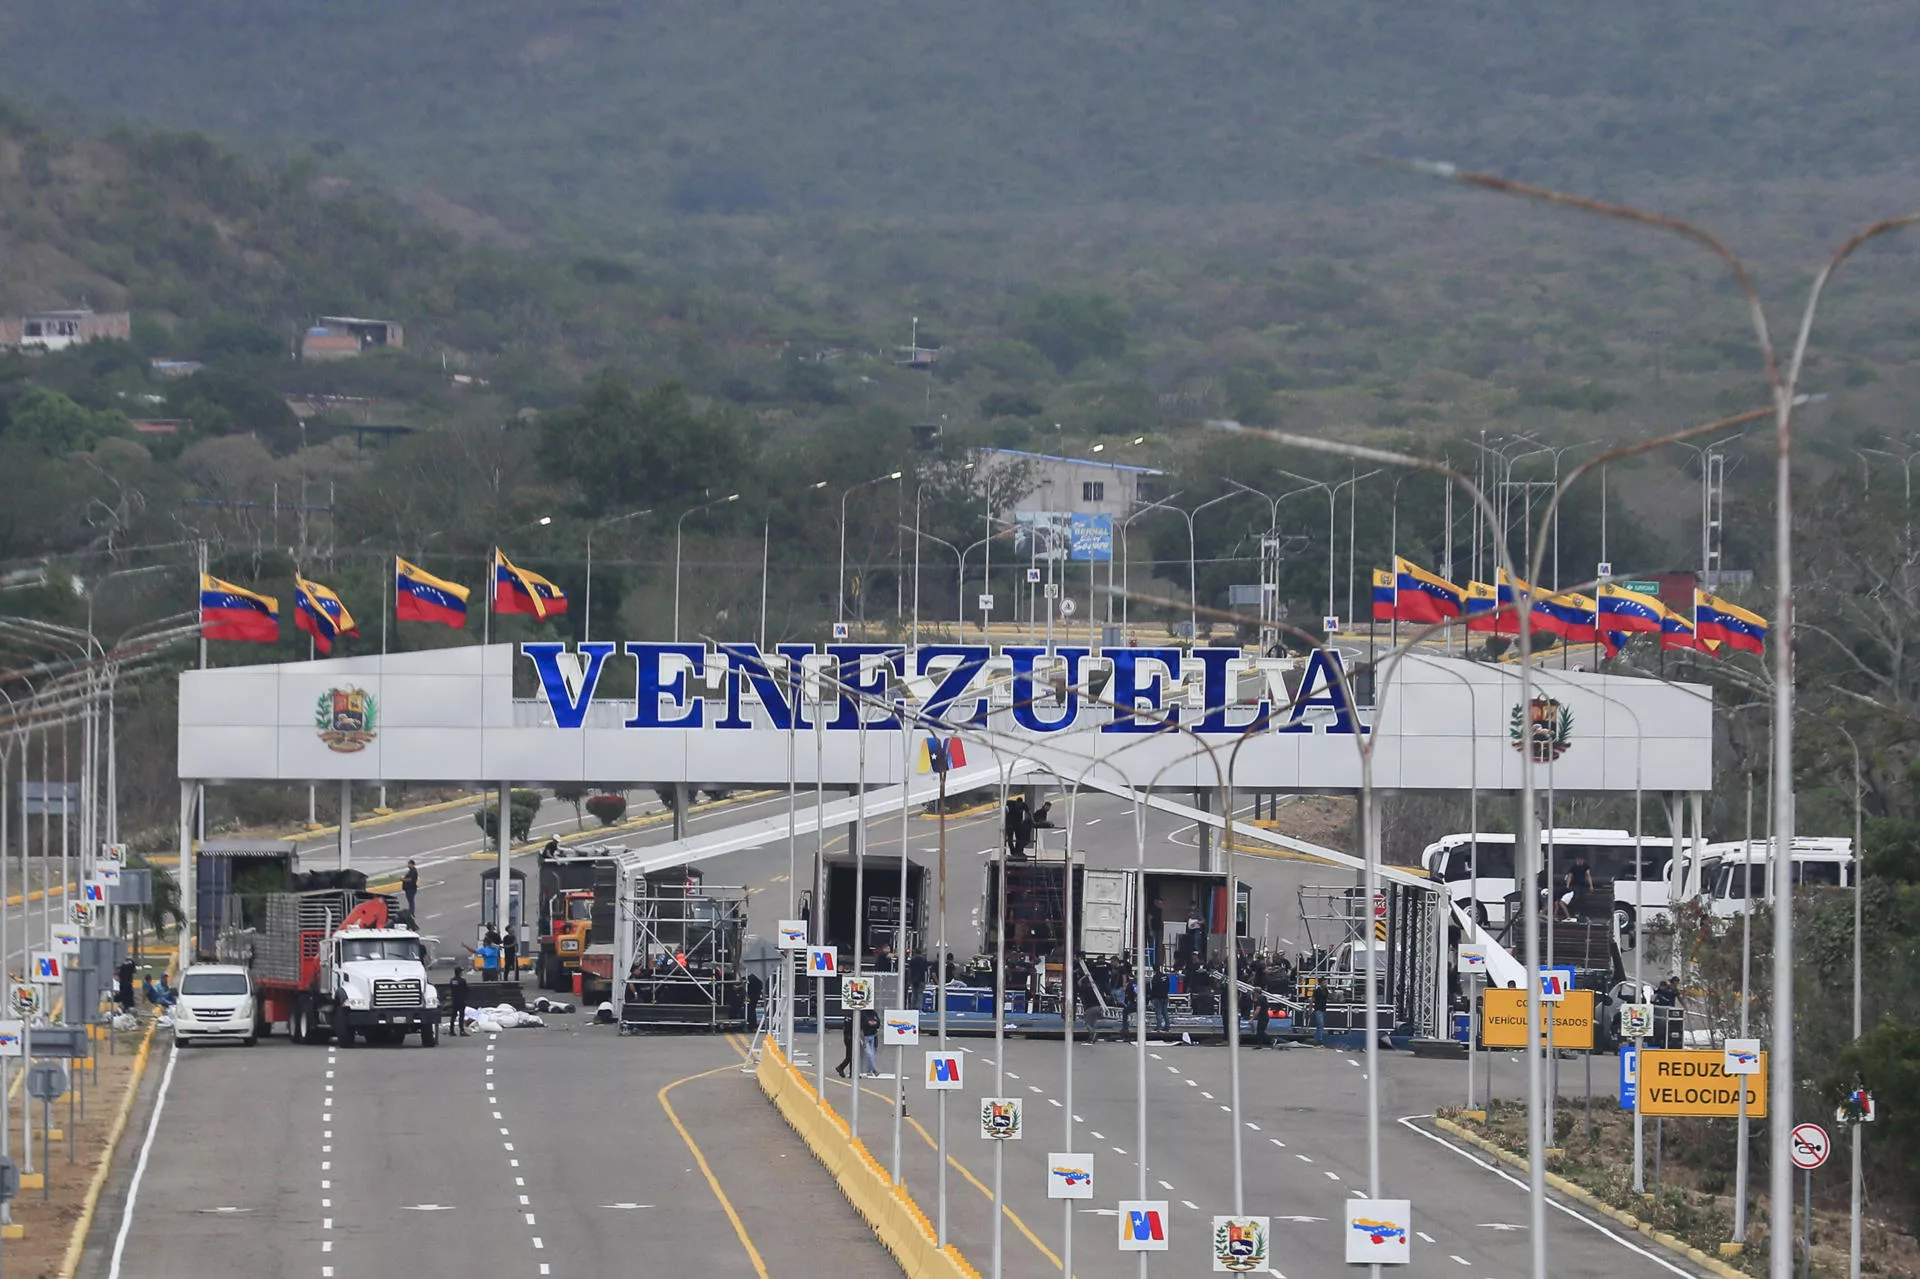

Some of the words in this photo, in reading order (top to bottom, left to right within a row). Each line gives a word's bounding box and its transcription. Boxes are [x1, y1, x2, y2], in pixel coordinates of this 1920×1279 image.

[521, 642, 1373, 735] VENEZUELA
[1489, 1013, 1528, 1025] VEHÍCUL
[1658, 1062, 1738, 1077] REDUZ
[1649, 1088, 1756, 1104] VELOCIDAD
